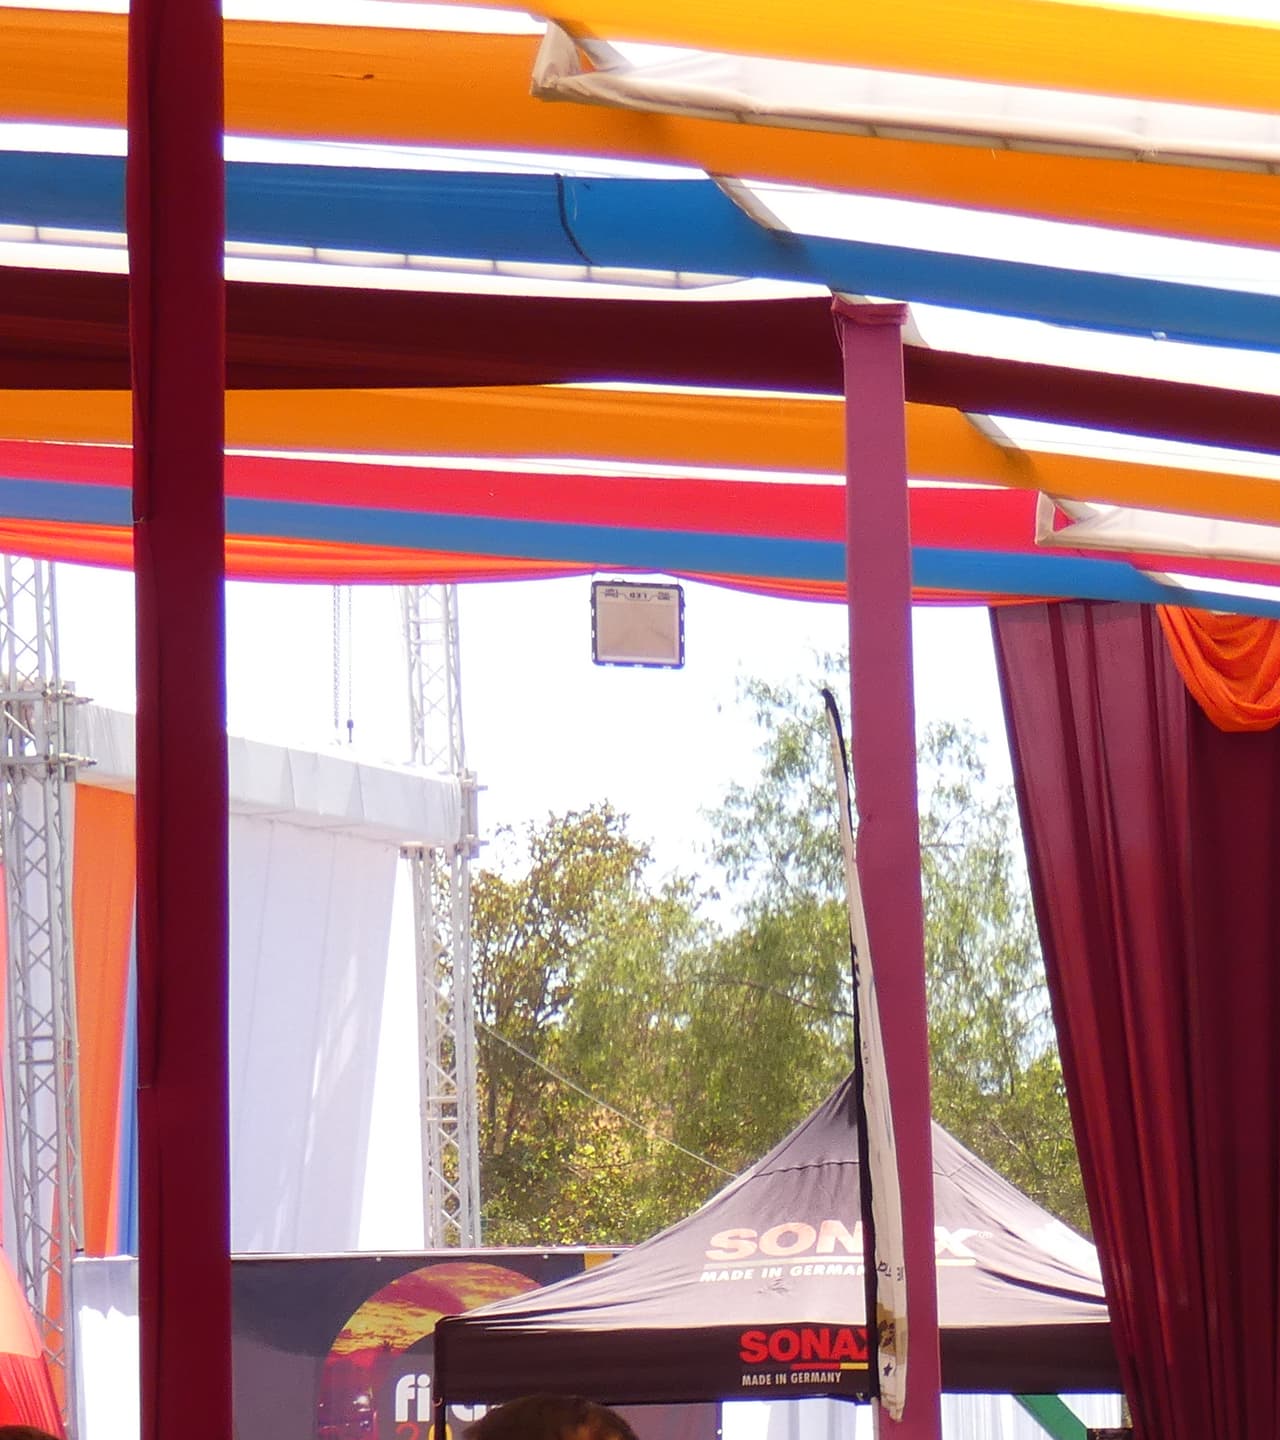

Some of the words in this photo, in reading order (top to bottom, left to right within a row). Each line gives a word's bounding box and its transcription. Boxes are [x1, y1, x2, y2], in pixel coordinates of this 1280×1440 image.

[705, 1220, 980, 1262] SONX
[700, 1268, 753, 1283] MADE
[761, 1267, 783, 1279] IN
[742, 1374, 772, 1386] MADE
[775, 1373, 787, 1385] IN
[791, 1371, 842, 1384] GERMANY
